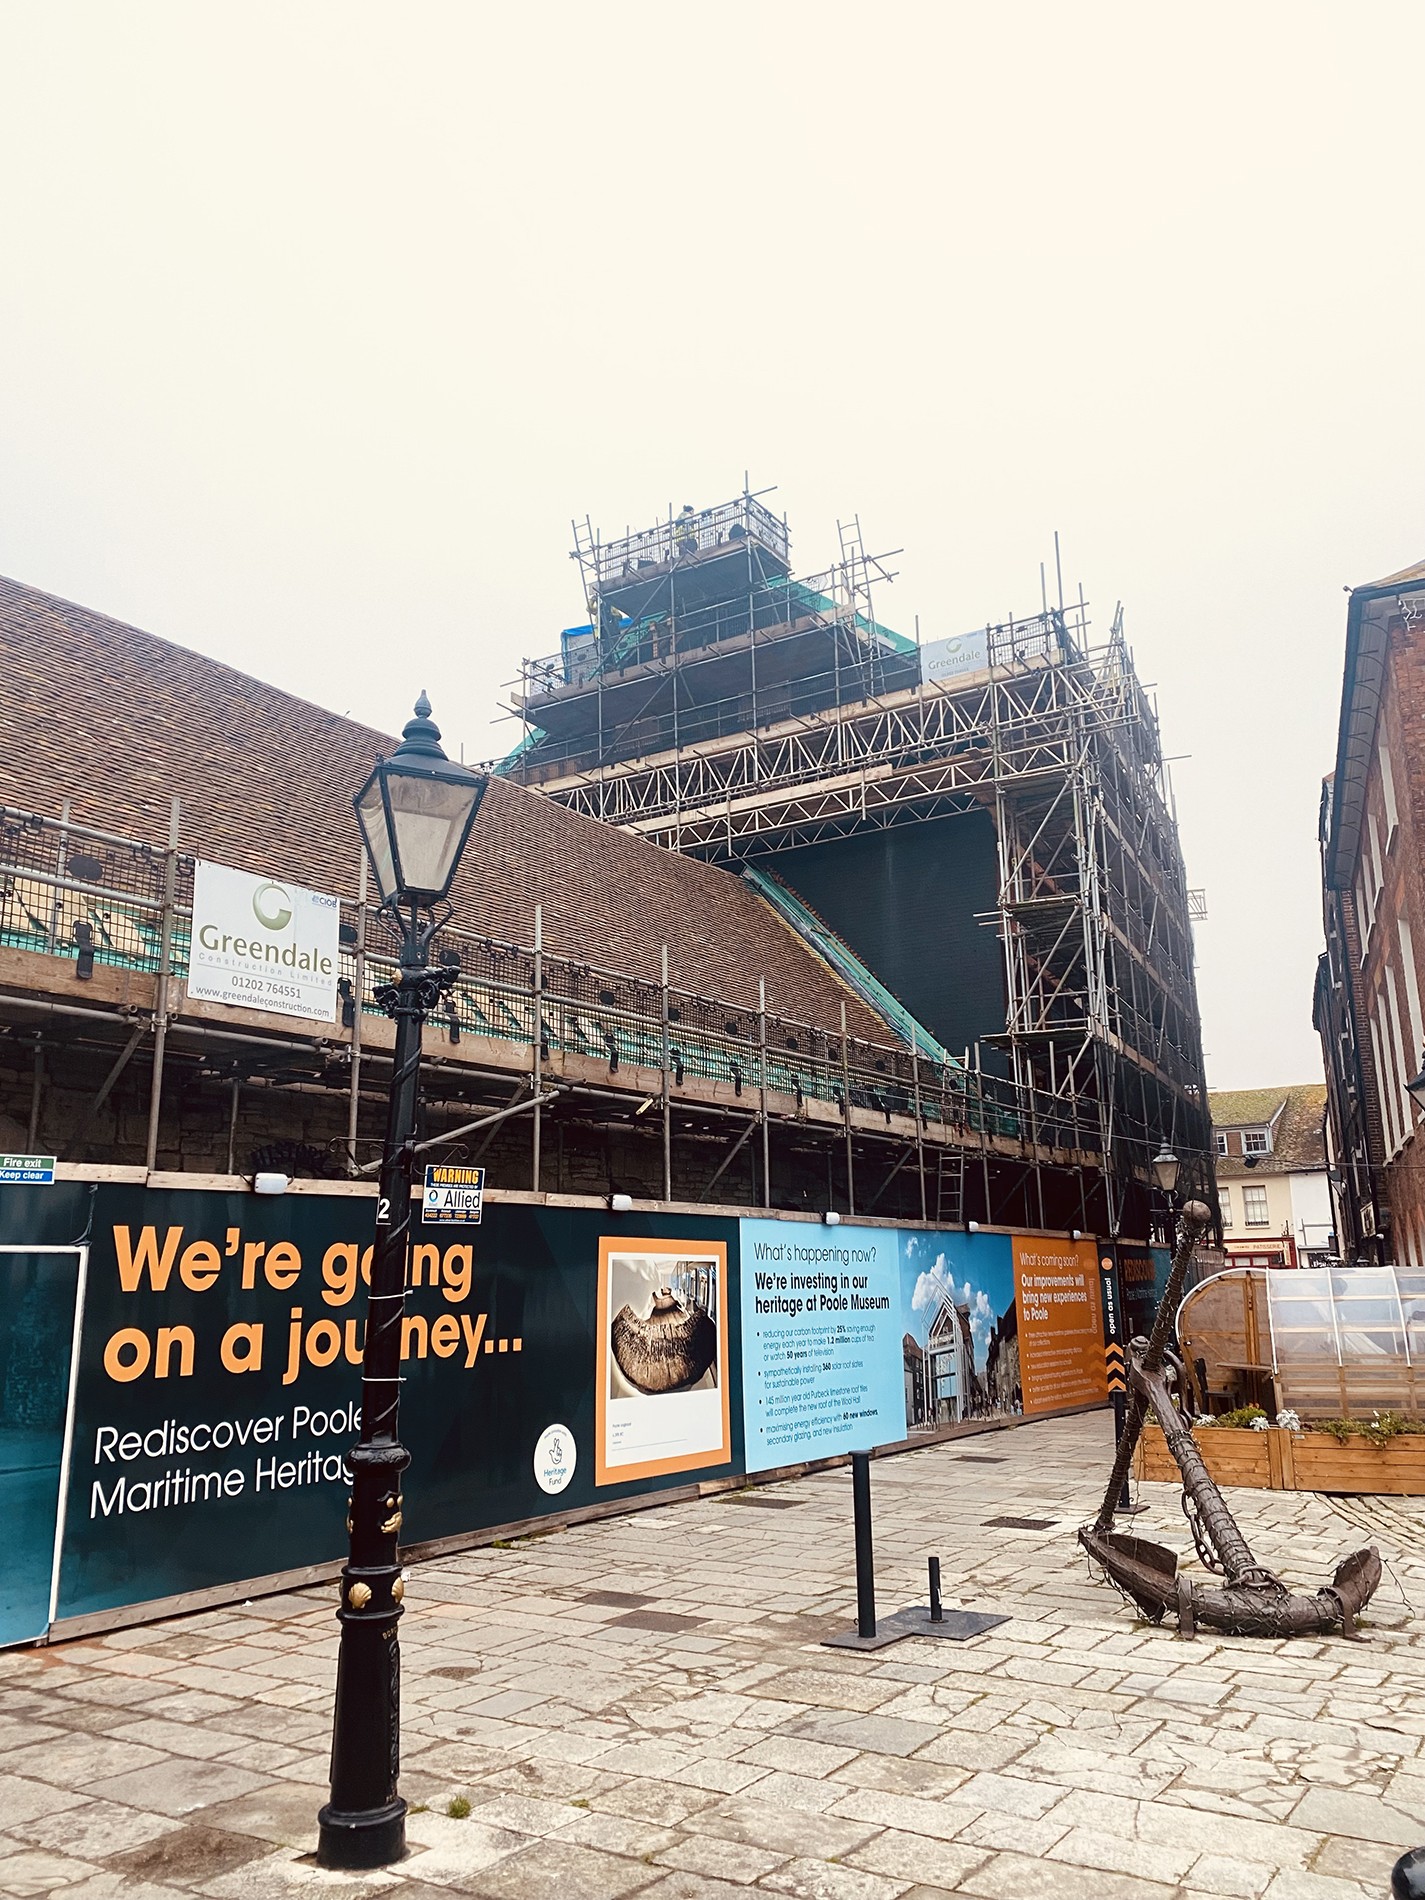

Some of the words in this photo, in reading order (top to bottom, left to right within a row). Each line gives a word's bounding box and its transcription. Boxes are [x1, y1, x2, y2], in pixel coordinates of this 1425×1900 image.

[928, 650, 980, 670] Greendale
[200, 924, 332, 975] Greendale
[198, 952, 282, 976] Construction
[290, 972, 332, 986] Limited
[232, 976, 264, 992] 01202
[266, 982, 301, 998] 764551
[196, 986, 330, 1017] www.greendaleconstruction.com
[4, 1158, 22, 1167] Fire
[24, 1158, 42, 1168] exit
[0, 1170, 21, 1180] Keep
[433, 1167, 479, 1184] WARNING
[378, 1198, 390, 1218] 2
[444, 1190, 480, 1208] Allied
[794, 1244, 849, 1266] happening
[852, 1247, 876, 1262] now?
[1042, 1254, 1062, 1269] coming
[1064, 1255, 1079, 1266] soon?
[113, 1225, 302, 1292] We’re
[321, 1231, 474, 1307] gng
[790, 1273, 838, 1293] investing
[840, 1273, 849, 1289] in
[852, 1276, 868, 1289] our
[1022, 1274, 1033, 1287] Our
[1034, 1274, 1074, 1289] improvements
[1075, 1274, 1084, 1286] will
[1104, 1278, 1113, 1300] usual
[755, 1296, 802, 1317] heritage
[806, 1294, 816, 1311] at
[820, 1294, 848, 1311] Poole
[851, 1294, 889, 1310] Museum
[1022, 1290, 1038, 1307] bring
[1040, 1293, 1052, 1303] new
[1053, 1290, 1087, 1305] experiences
[1107, 1301, 1113, 1312] as
[1023, 1308, 1030, 1321] to
[1031, 1307, 1048, 1320] Poole
[763, 1330, 784, 1339] reducing
[794, 1328, 810, 1336] carbon
[812, 1326, 830, 1335] footprint
[837, 1325, 846, 1333] 25%
[860, 1324, 875, 1333] enough
[104, 1325, 196, 1382] on
[220, 1322, 264, 1374] a
[282, 1307, 522, 1385] jouney...
[763, 1342, 781, 1351] energy
[782, 1340, 795, 1348] each
[796, 1339, 806, 1348] year
[813, 1338, 826, 1346] make
[770, 1351, 785, 1360] watch
[787, 1351, 793, 1359] 50
[794, 1351, 807, 1360] years
[814, 1348, 834, 1357] television
[764, 1366, 801, 1378] sympathetically
[803, 1364, 821, 1373] installing
[822, 1363, 831, 1371] 360
[832, 1362, 842, 1370] solar
[772, 1378, 799, 1388] sustainable
[800, 1376, 815, 1386] power
[775, 1395, 790, 1404] million
[791, 1394, 801, 1403] year
[811, 1389, 829, 1398] Purbeck
[830, 1387, 850, 1396] limestone
[851, 1386, 859, 1394] roof
[765, 1408, 773, 1417] will
[774, 1406, 798, 1417] complete
[818, 1400, 827, 1409] roof
[828, 1399, 832, 1407] of
[842, 1397, 852, 1405] Wool
[766, 1422, 793, 1433] maximising
[794, 1420, 810, 1430] energy
[811, 1415, 832, 1427] efficiency
[833, 1414, 842, 1422] with
[94, 1415, 284, 1464] Rediscover
[767, 1434, 793, 1446] secondary
[812, 1428, 822, 1437] and
[823, 1427, 832, 1435] new
[833, 1423, 853, 1432] insulation
[544, 1467, 567, 1477] Heritage
[548, 1477, 562, 1486] Fund
[90, 1468, 245, 1518] Maritime
